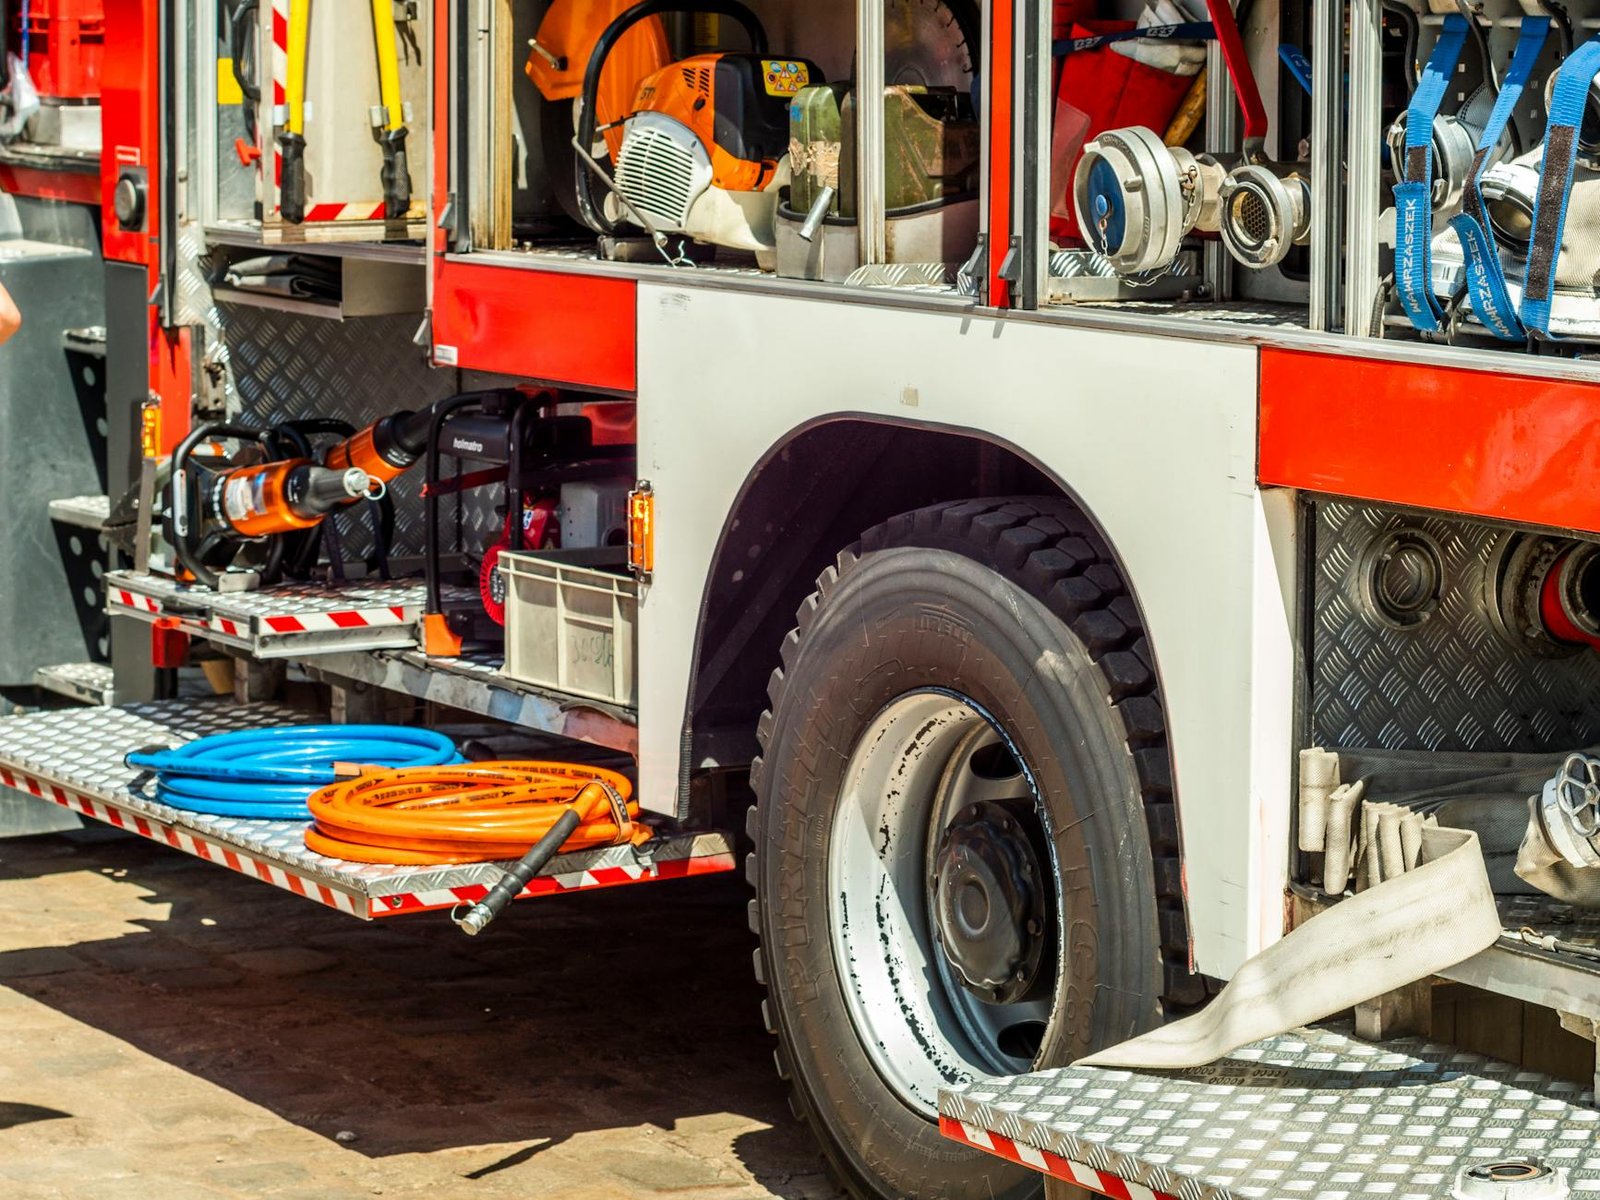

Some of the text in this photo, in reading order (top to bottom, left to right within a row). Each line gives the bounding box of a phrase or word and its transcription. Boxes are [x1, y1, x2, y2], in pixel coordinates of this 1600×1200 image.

[1402, 198, 1422, 313] WAWRZASZEK
[1464, 229, 1514, 338] WAWRZASZEK
[452, 436, 484, 453] holmatro
